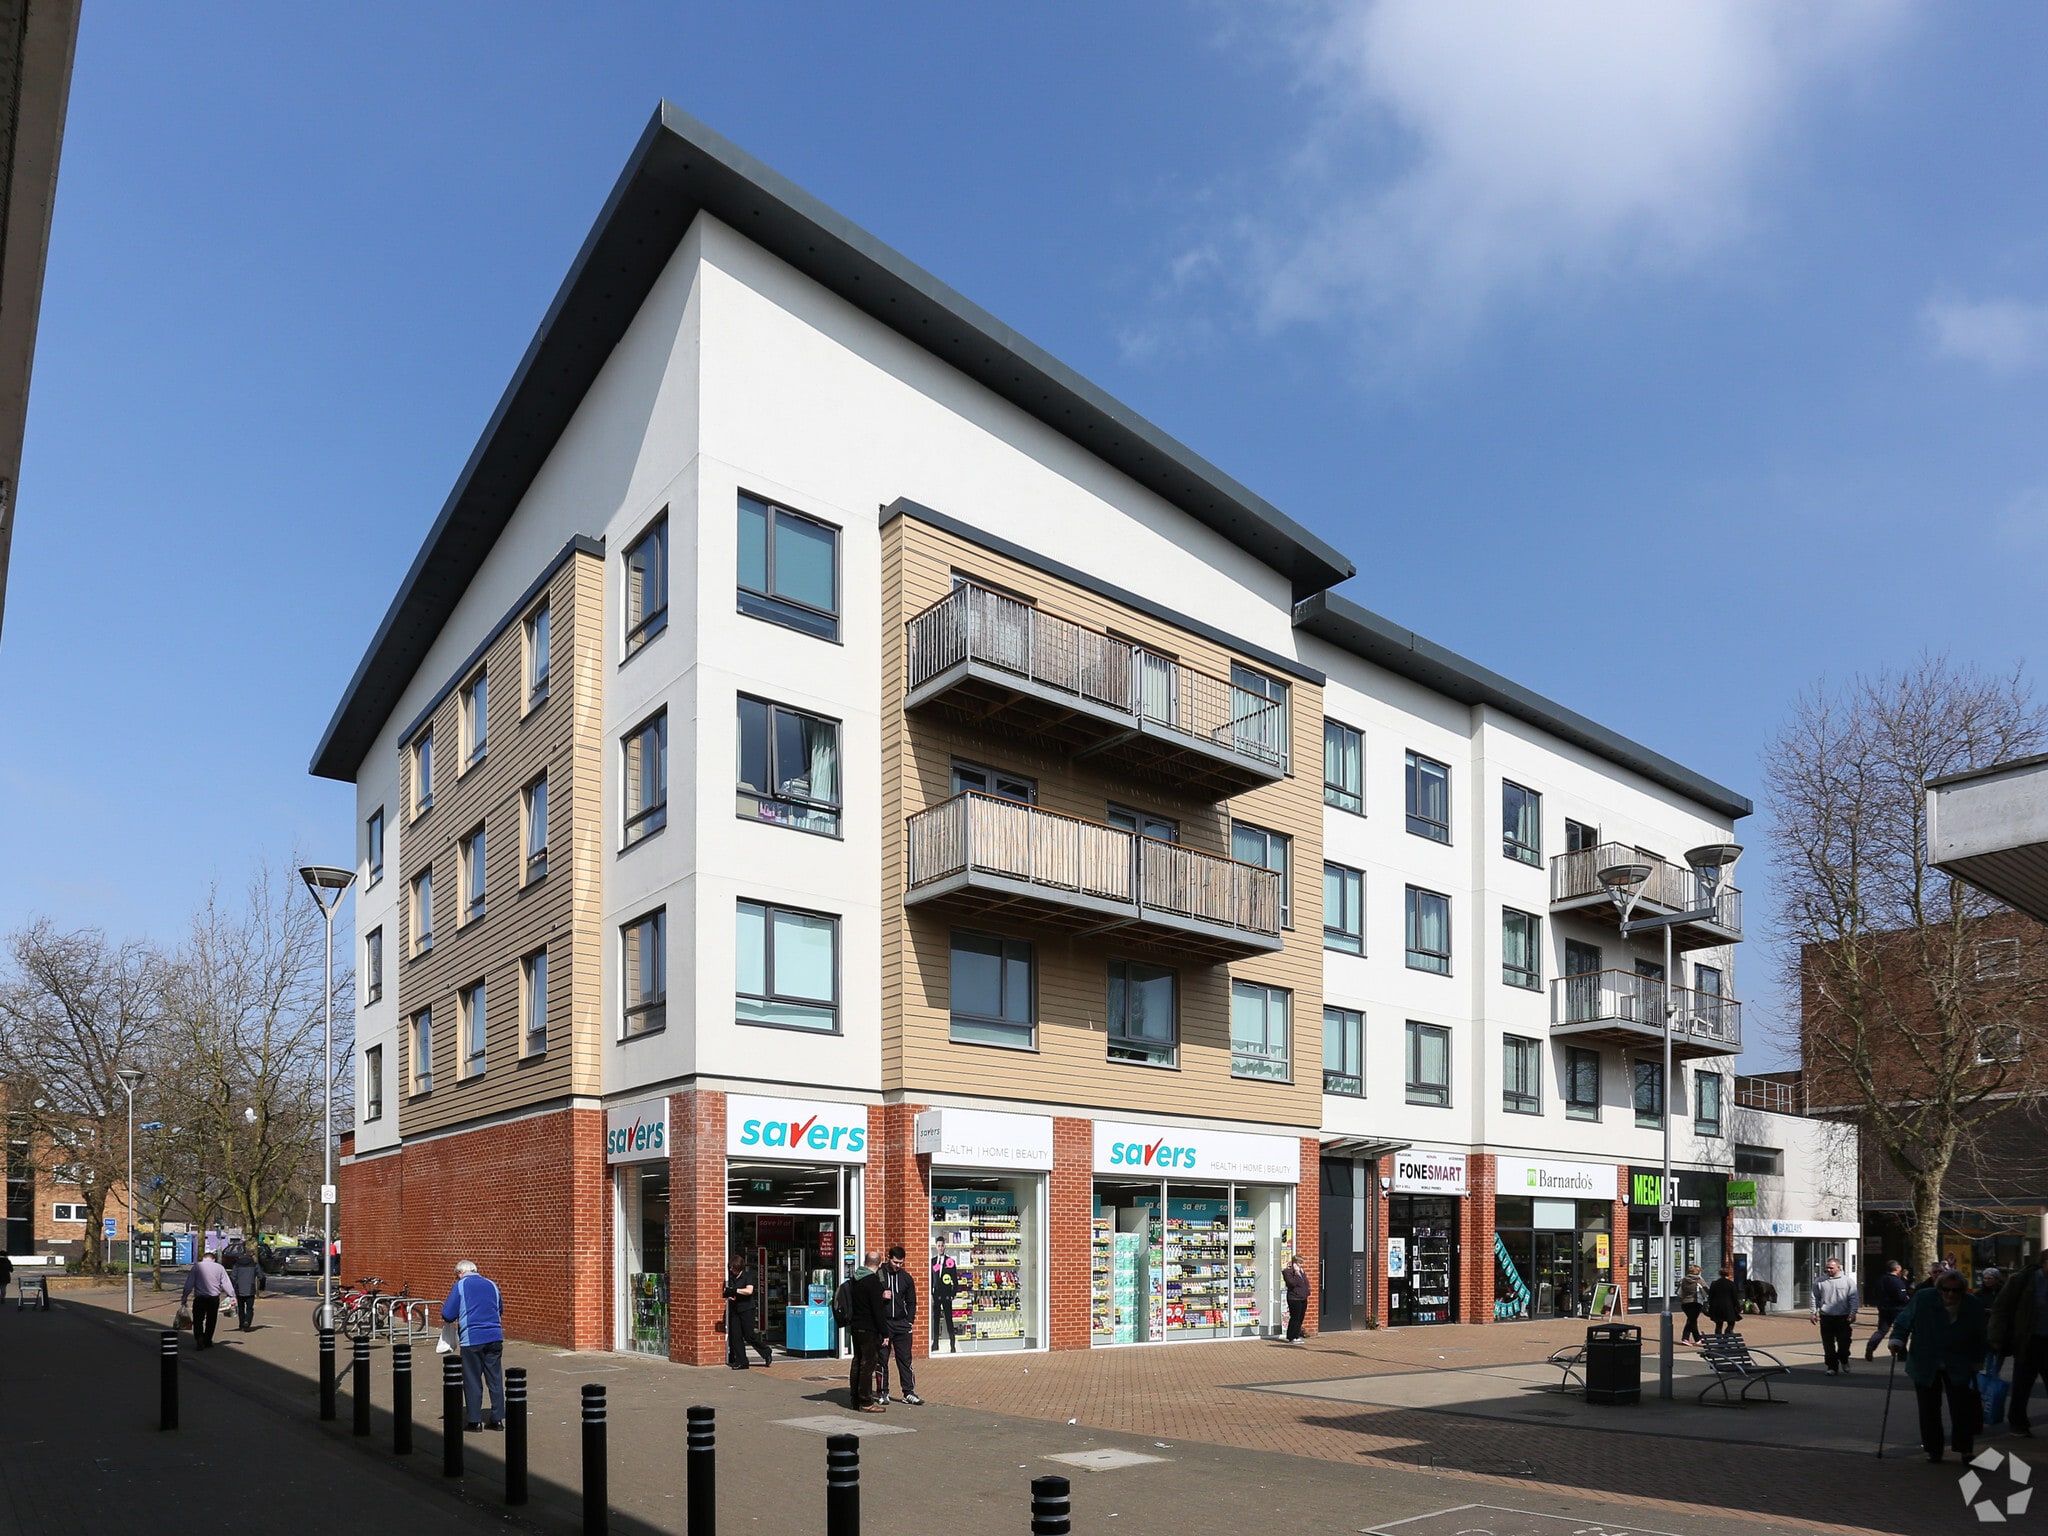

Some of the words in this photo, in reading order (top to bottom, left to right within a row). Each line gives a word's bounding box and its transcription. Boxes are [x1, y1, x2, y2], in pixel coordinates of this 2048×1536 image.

[607, 1116, 664, 1154] savers
[740, 1115, 865, 1152] savers
[920, 1128, 940, 1137] savers
[944, 1145, 973, 1155] EALTH
[982, 1147, 1009, 1158] HOME
[1016, 1150, 1048, 1160] BEAUTY
[1110, 1137, 1196, 1169] savers
[1210, 1161, 1237, 1171] HEALTH
[1243, 1164, 1263, 1173] HOME
[1267, 1165, 1290, 1174] BEAUTY
[1399, 1163, 1462, 1182] FONESMART
[1539, 1169, 1593, 1190] Barnardo's
[1634, 1174, 1680, 1207] MEGAT
[845, 1239, 856, 1247] 30
